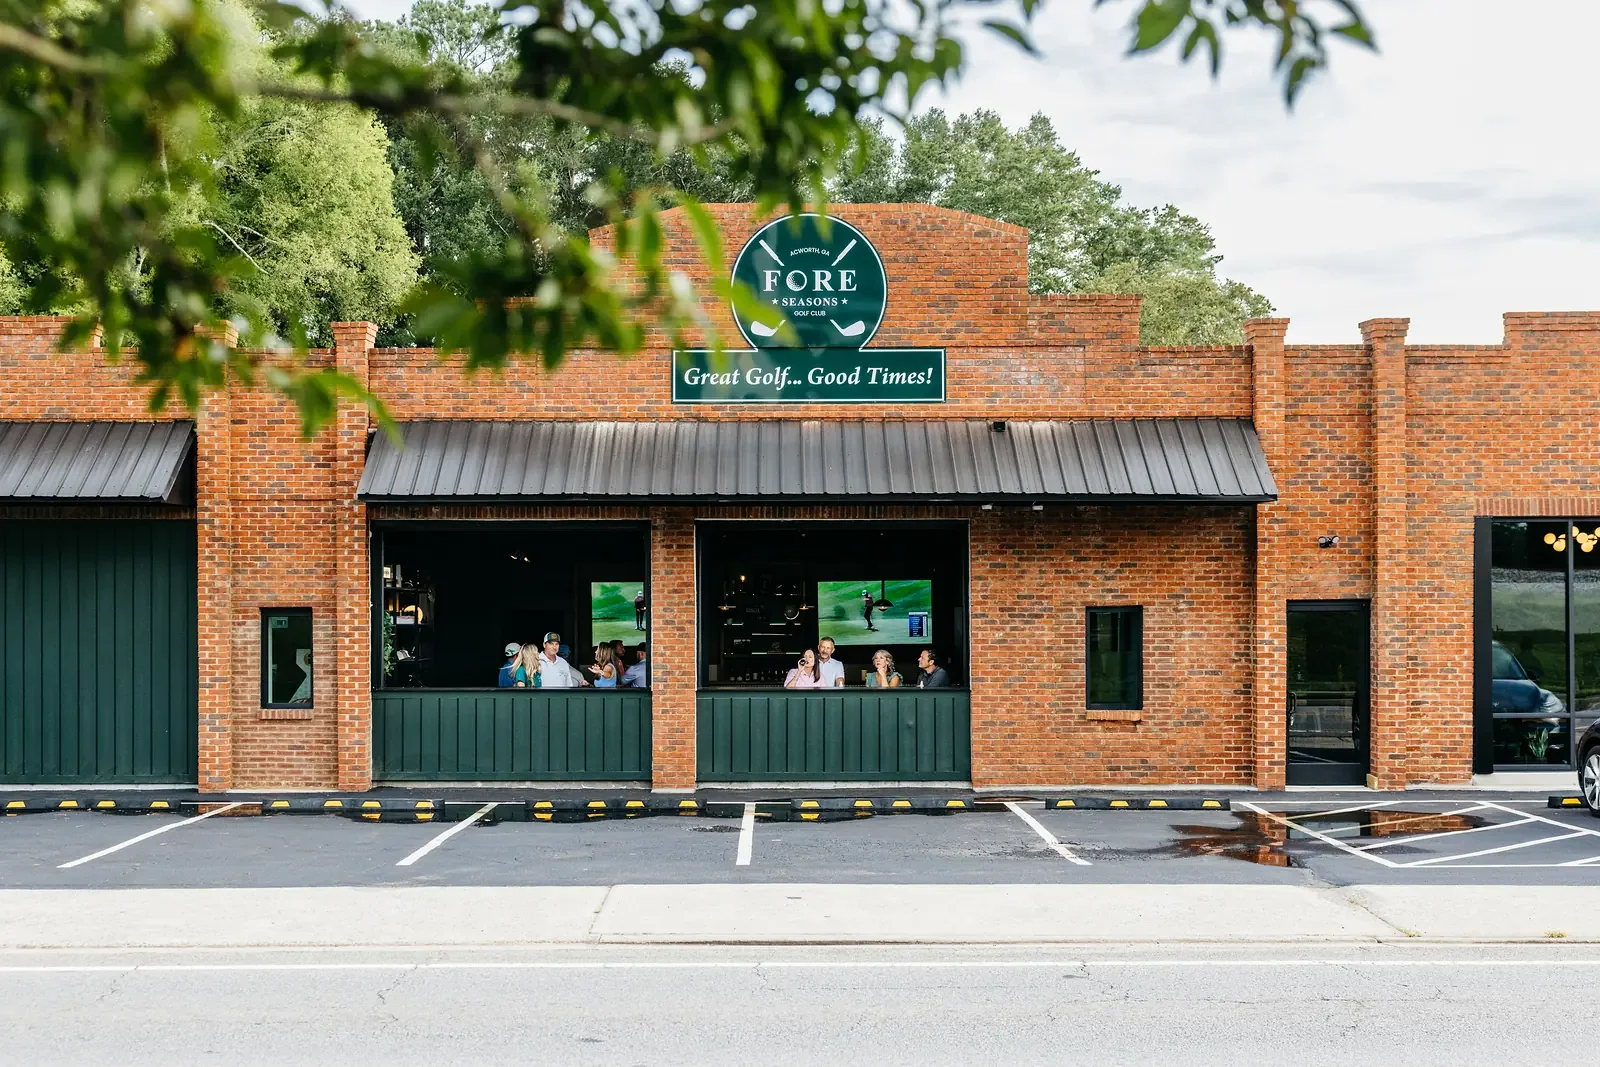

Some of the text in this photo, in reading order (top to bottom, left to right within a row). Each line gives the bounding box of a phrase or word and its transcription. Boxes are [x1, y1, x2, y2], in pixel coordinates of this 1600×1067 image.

[763, 270, 857, 292] FORE
[781, 297, 838, 307] SEASONS
[684, 366, 934, 391] Great Golf... Good Times!
